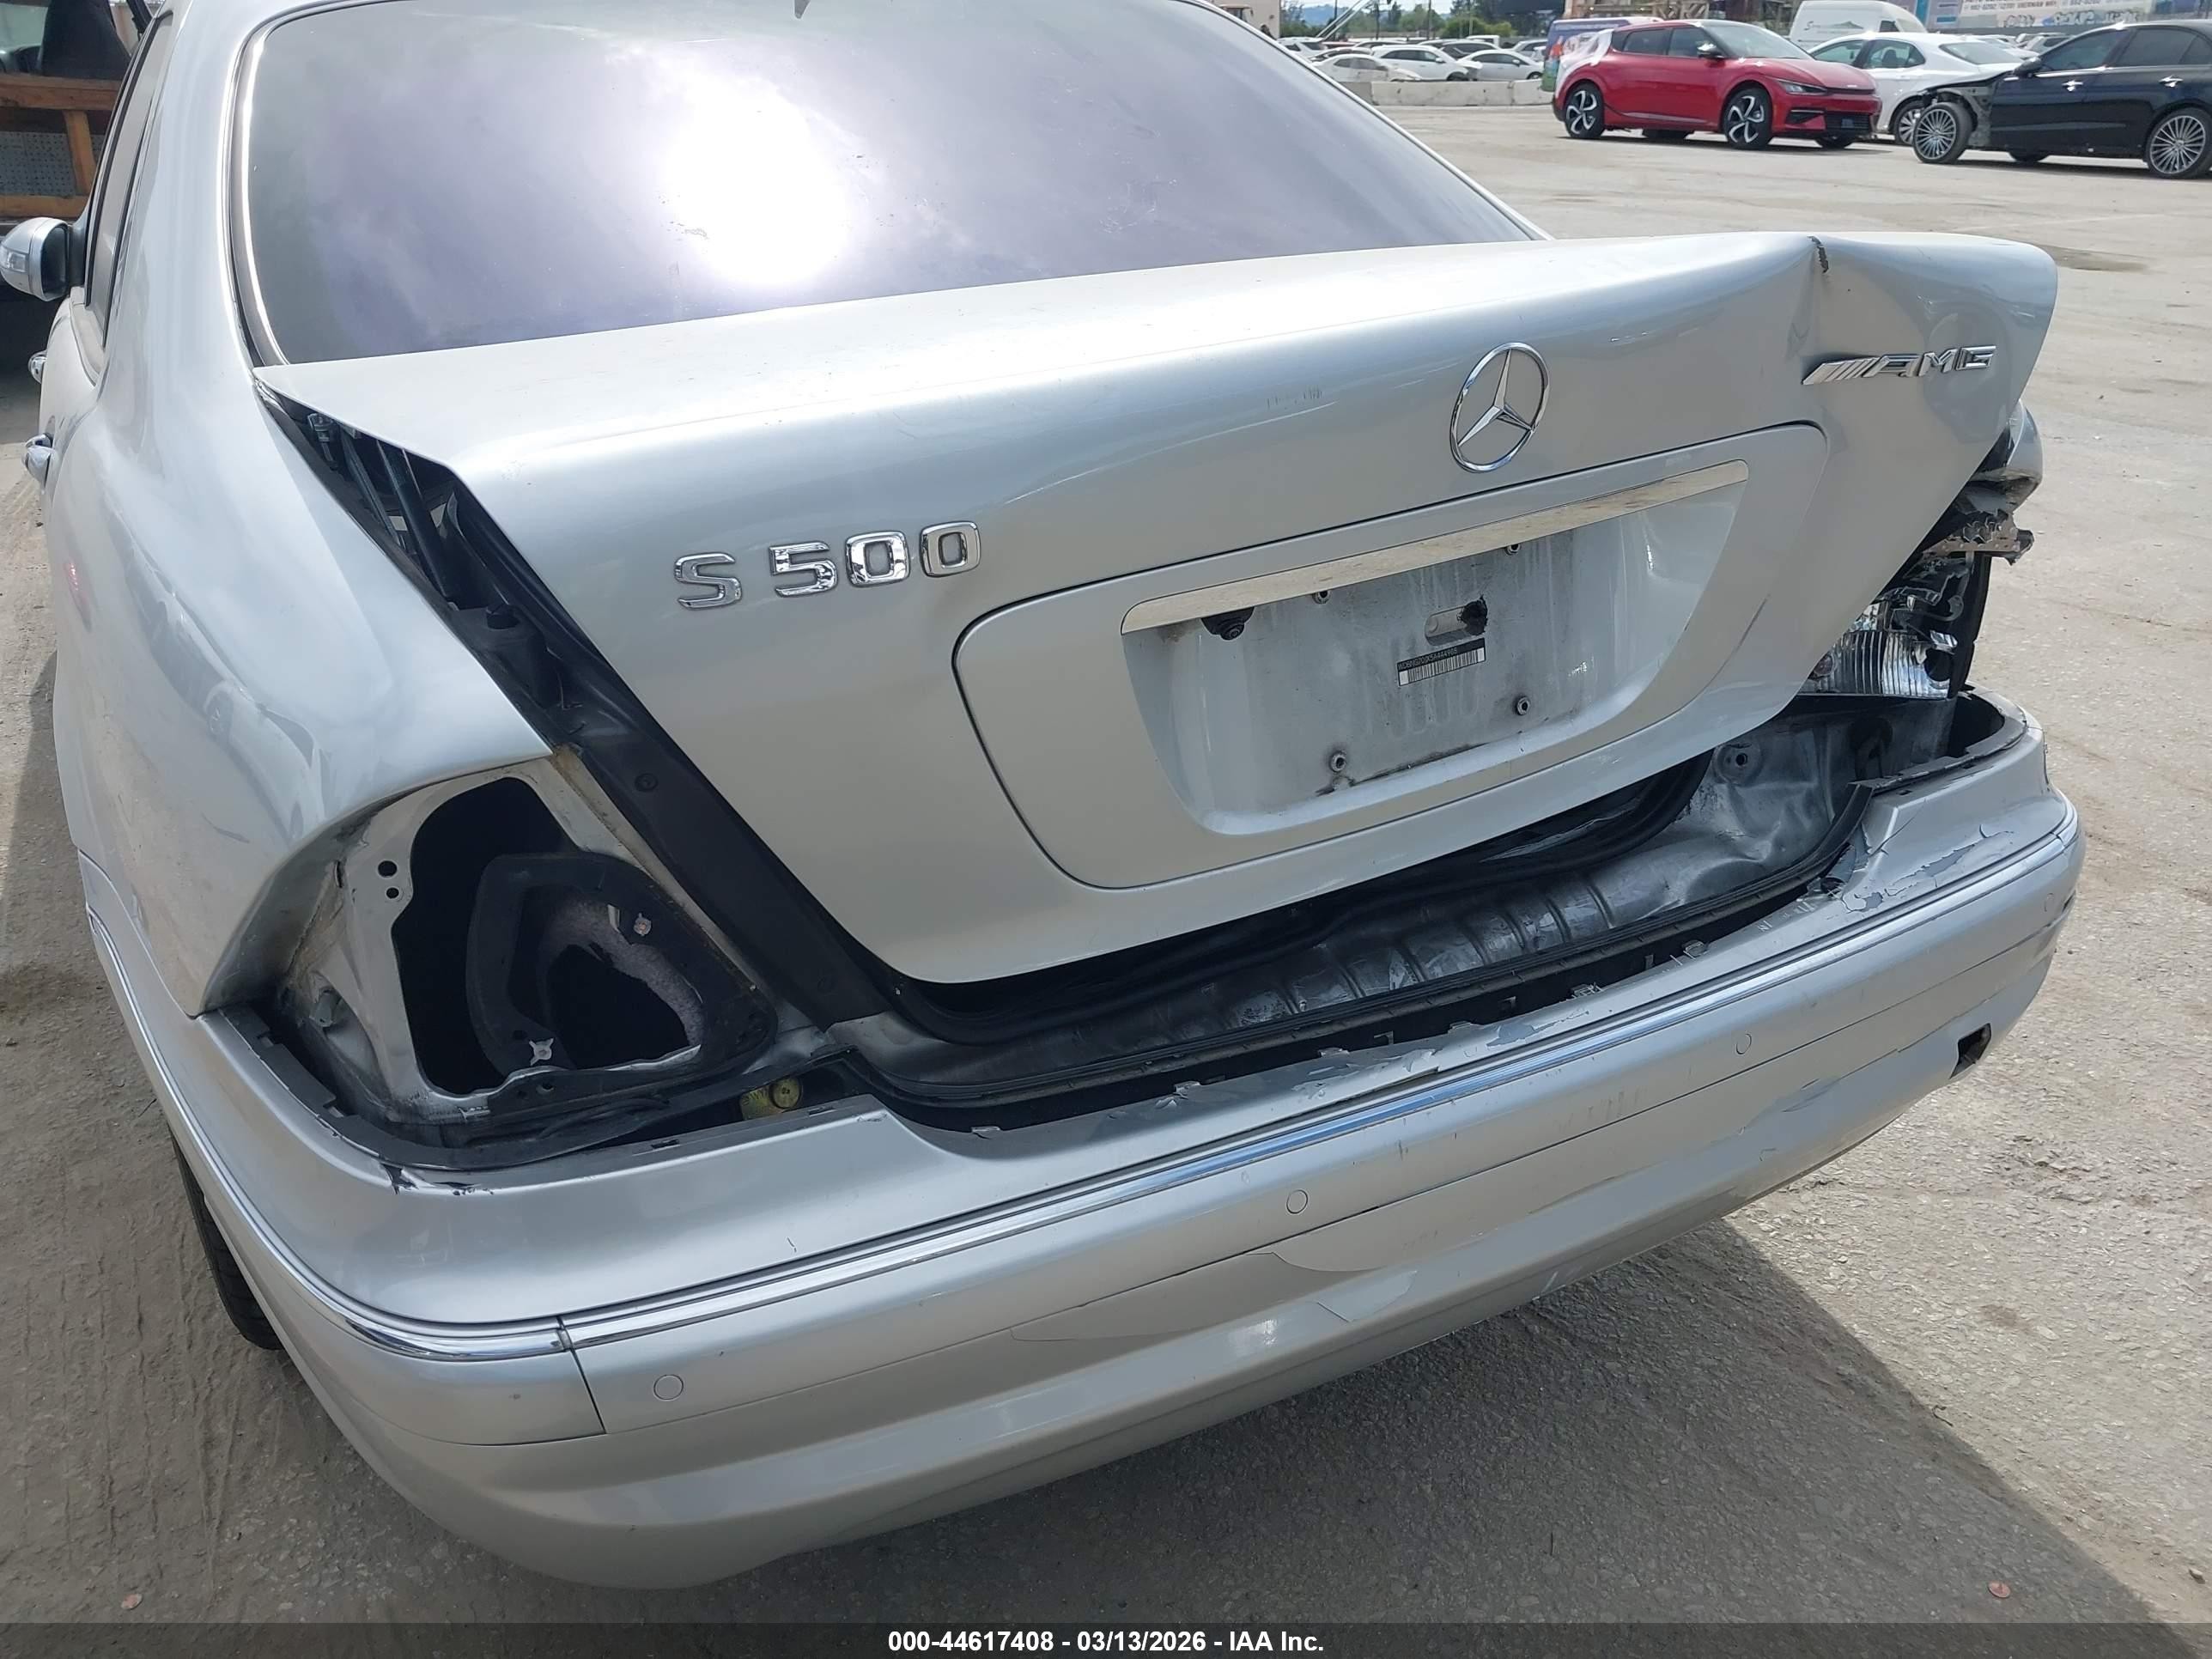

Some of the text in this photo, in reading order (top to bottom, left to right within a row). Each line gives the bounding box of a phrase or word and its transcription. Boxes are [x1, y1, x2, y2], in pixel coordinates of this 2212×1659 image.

[1859, 345, 1996, 379] AMG
[674, 520, 981, 611] S 500
